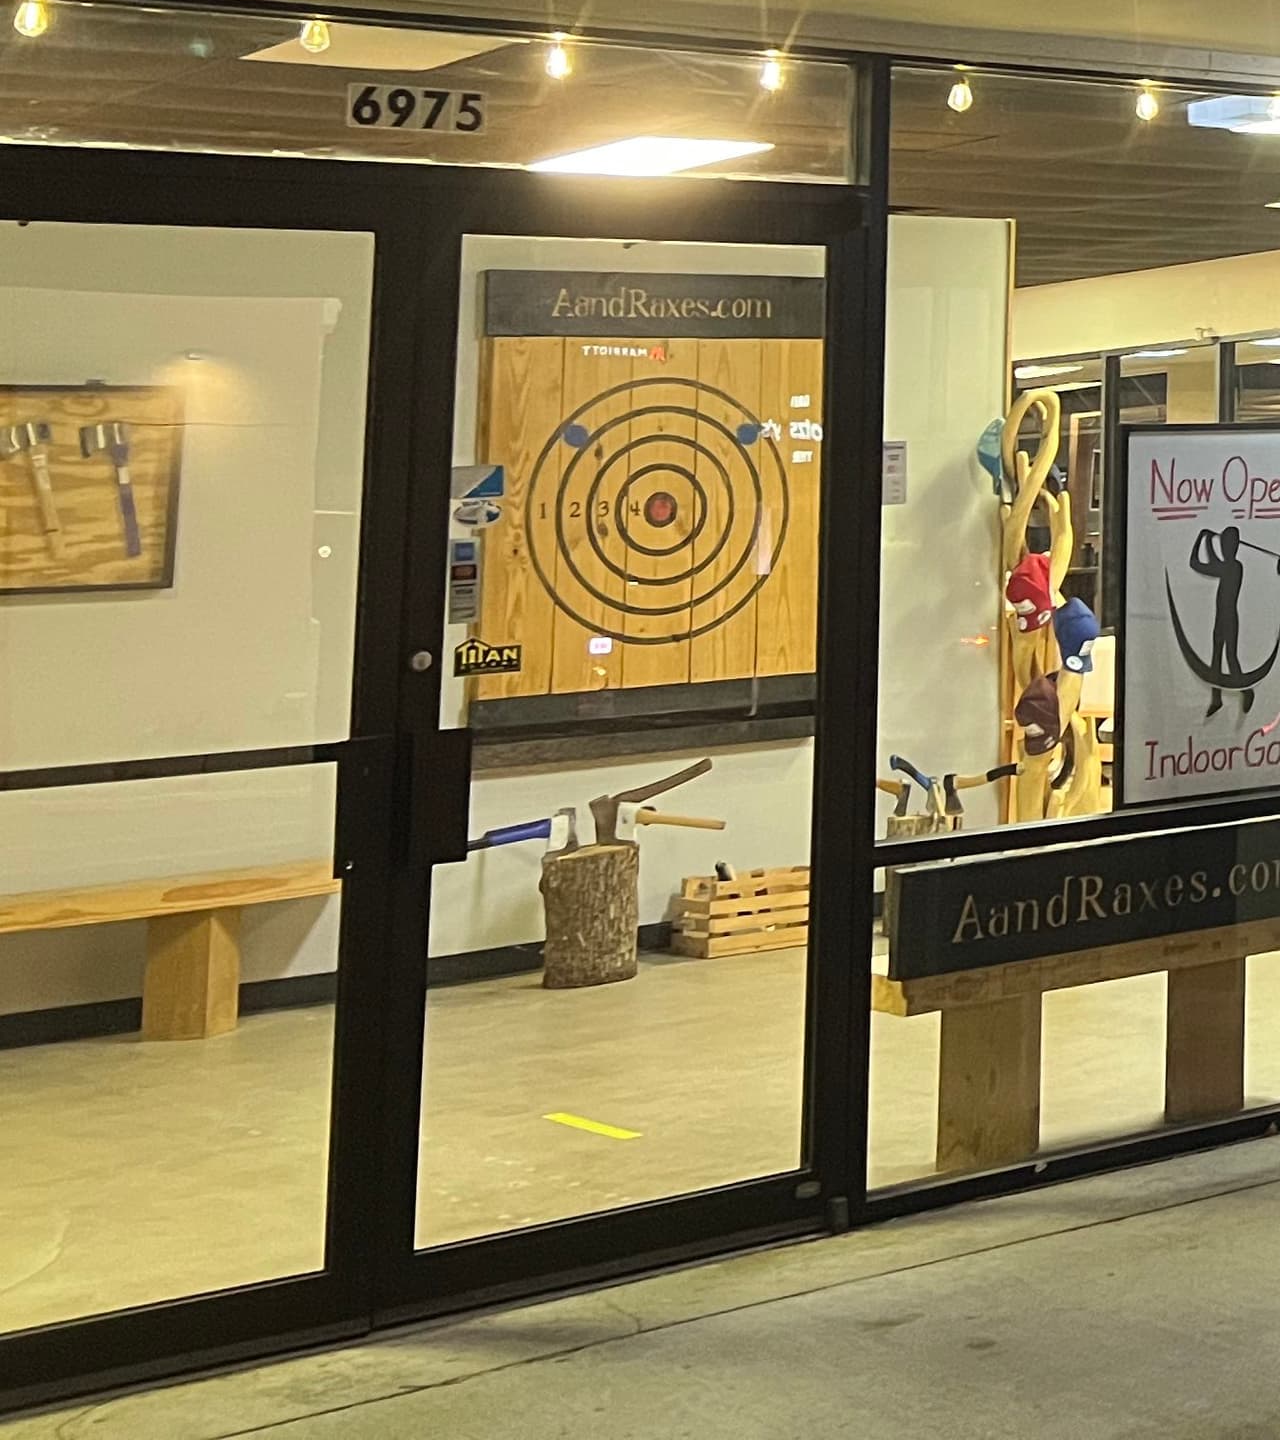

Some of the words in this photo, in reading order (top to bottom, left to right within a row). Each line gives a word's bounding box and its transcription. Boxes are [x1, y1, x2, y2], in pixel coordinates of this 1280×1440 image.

[352, 86, 483, 132] 6975
[551, 287, 772, 319] AandRaxes.com
[1151, 457, 1214, 505] Now
[539, 502, 546, 519] 1
[569, 501, 581, 518] 2
[598, 500, 610, 517] 3
[629, 500, 641, 516] 4
[456, 642, 519, 665] TITAN
